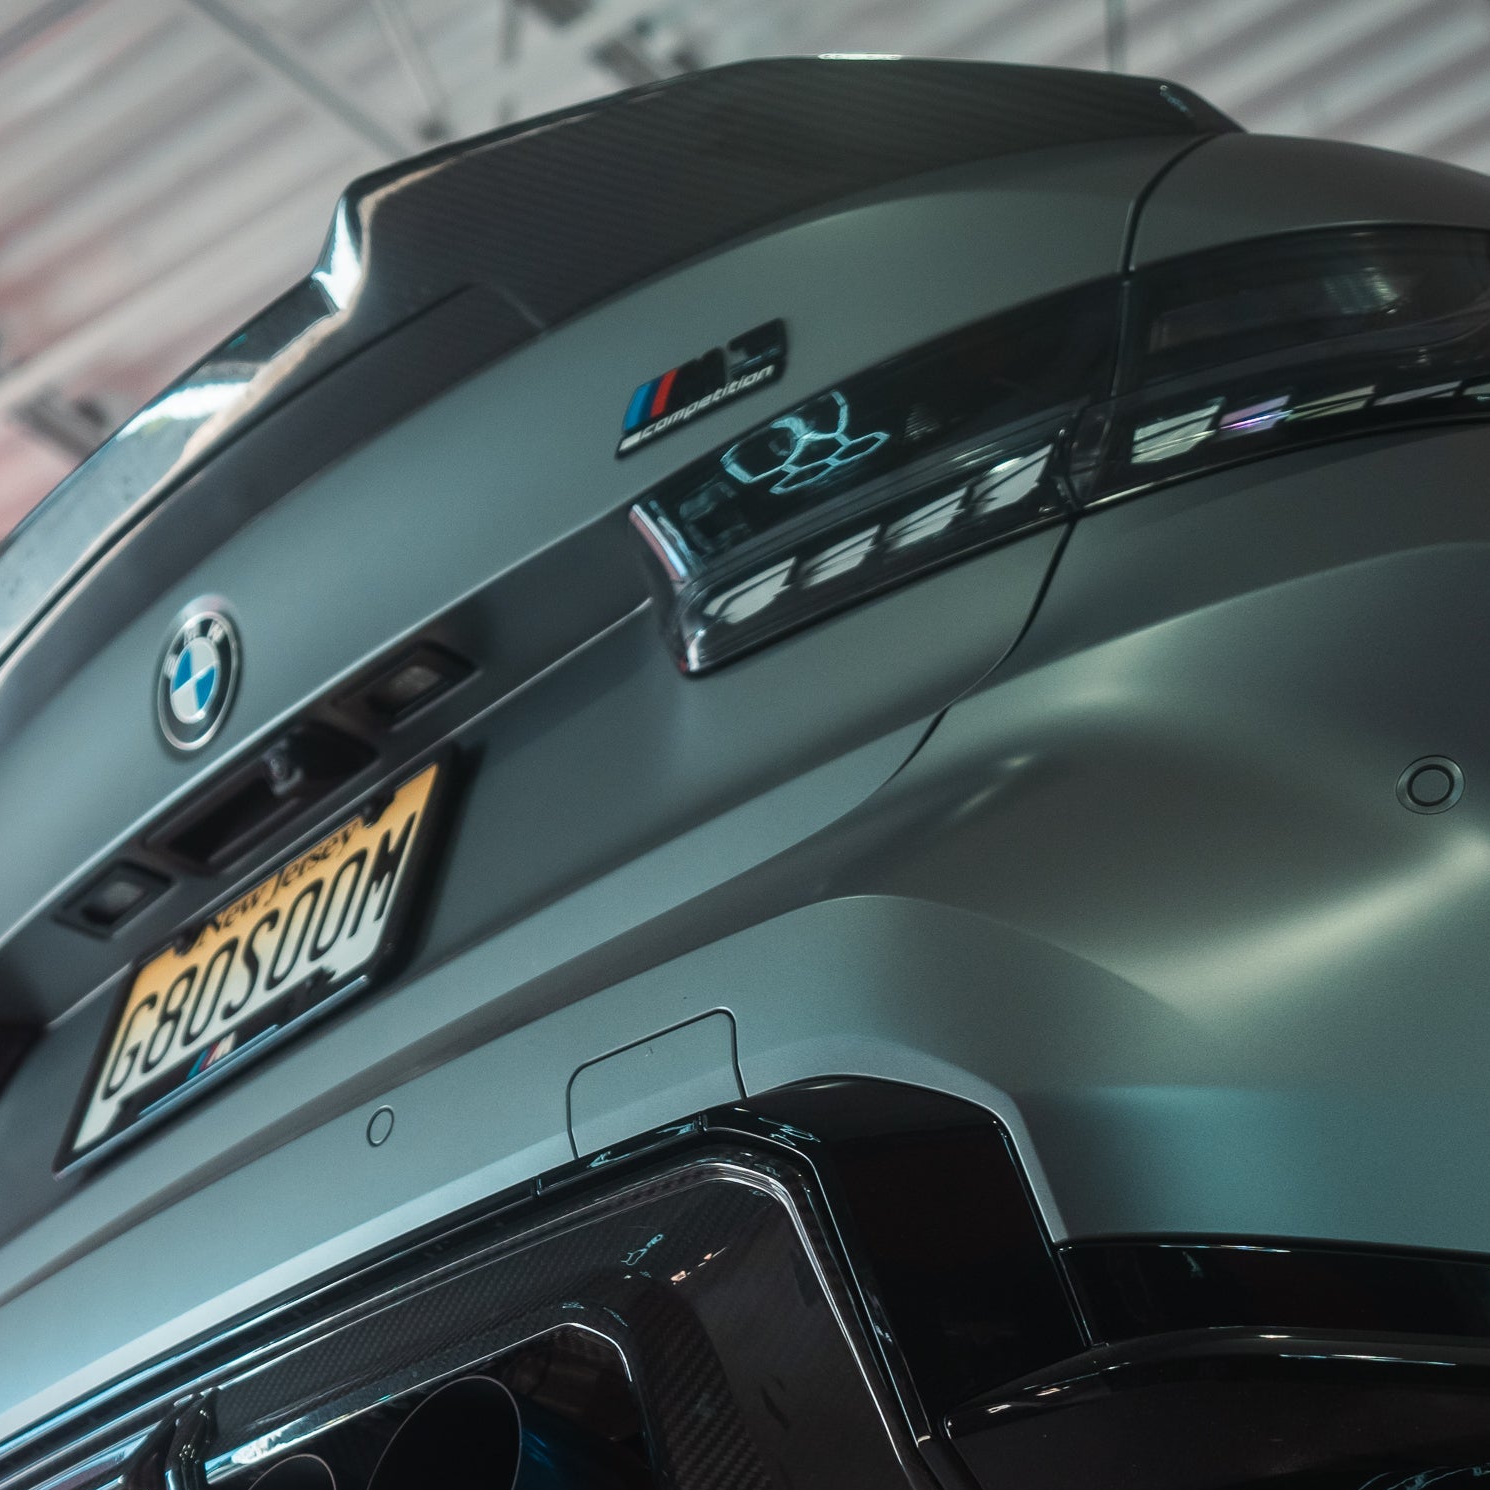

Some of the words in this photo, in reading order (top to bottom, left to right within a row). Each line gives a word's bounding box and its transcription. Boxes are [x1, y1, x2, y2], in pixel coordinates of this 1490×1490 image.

[639, 364, 777, 440] competition
[197, 888, 264, 948] New
[266, 821, 360, 900] Jersey
